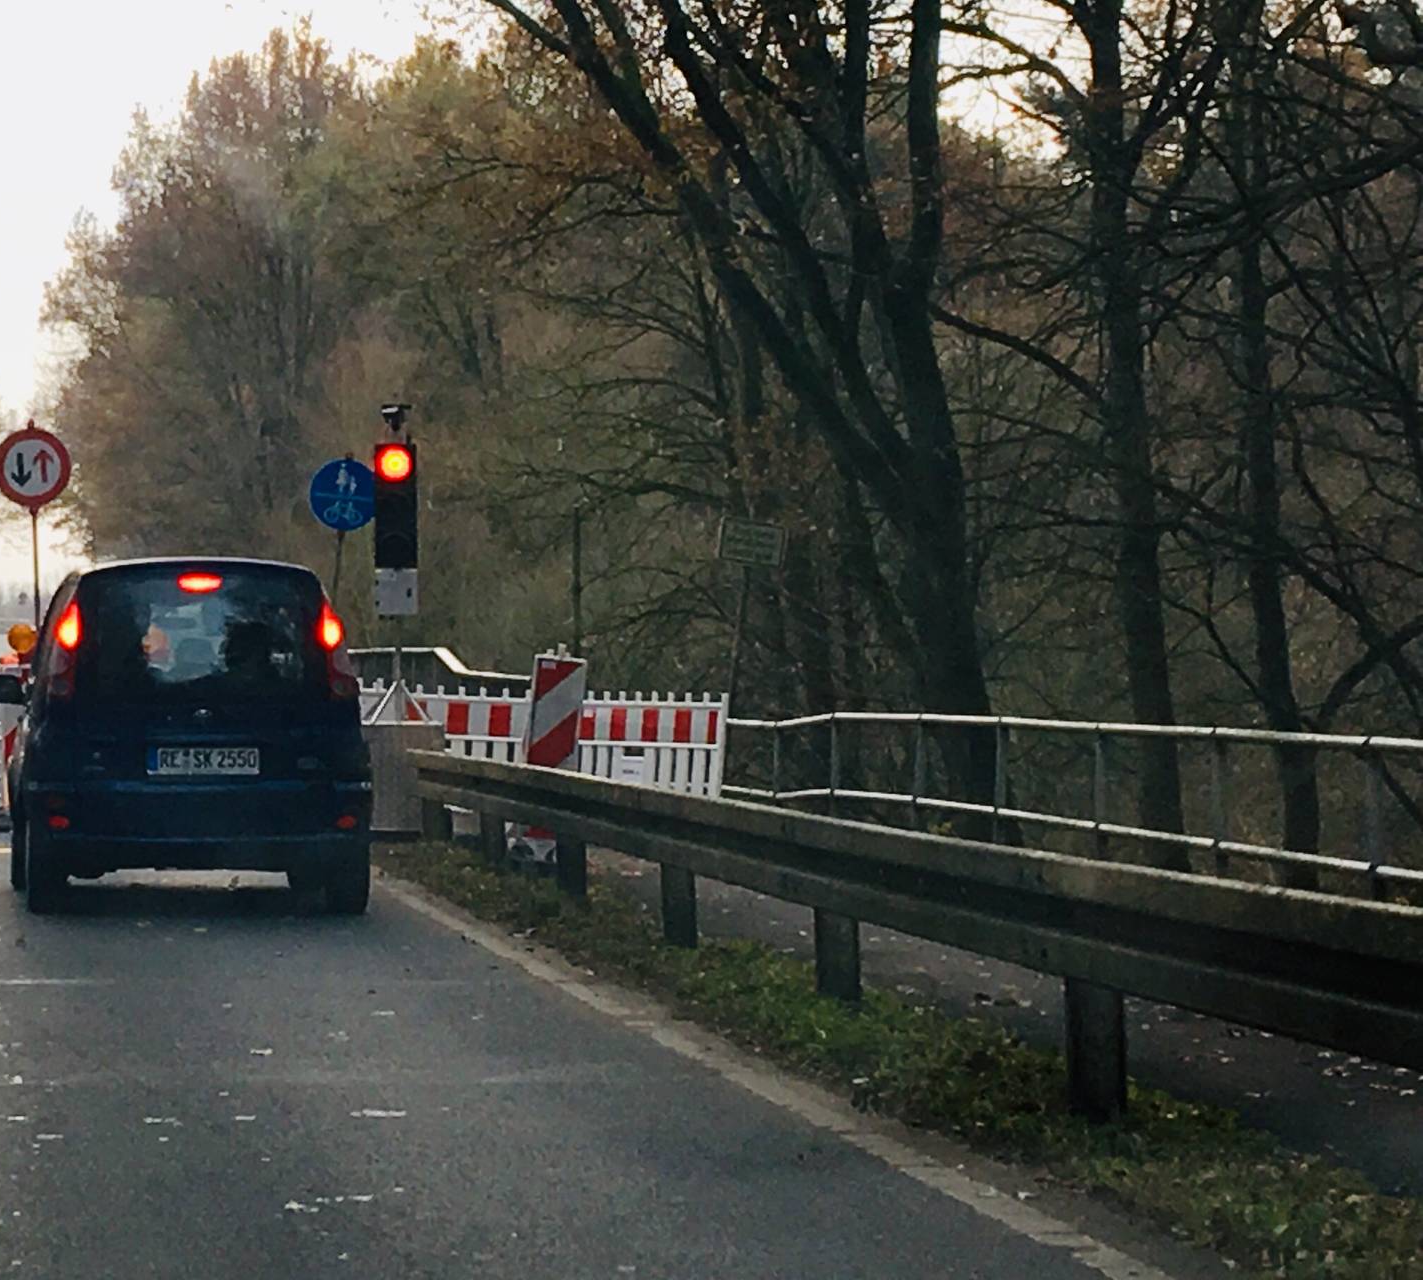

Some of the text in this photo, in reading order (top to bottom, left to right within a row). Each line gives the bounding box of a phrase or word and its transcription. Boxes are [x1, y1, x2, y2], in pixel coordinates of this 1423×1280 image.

[160, 750, 257, 768] RE SK 2550
